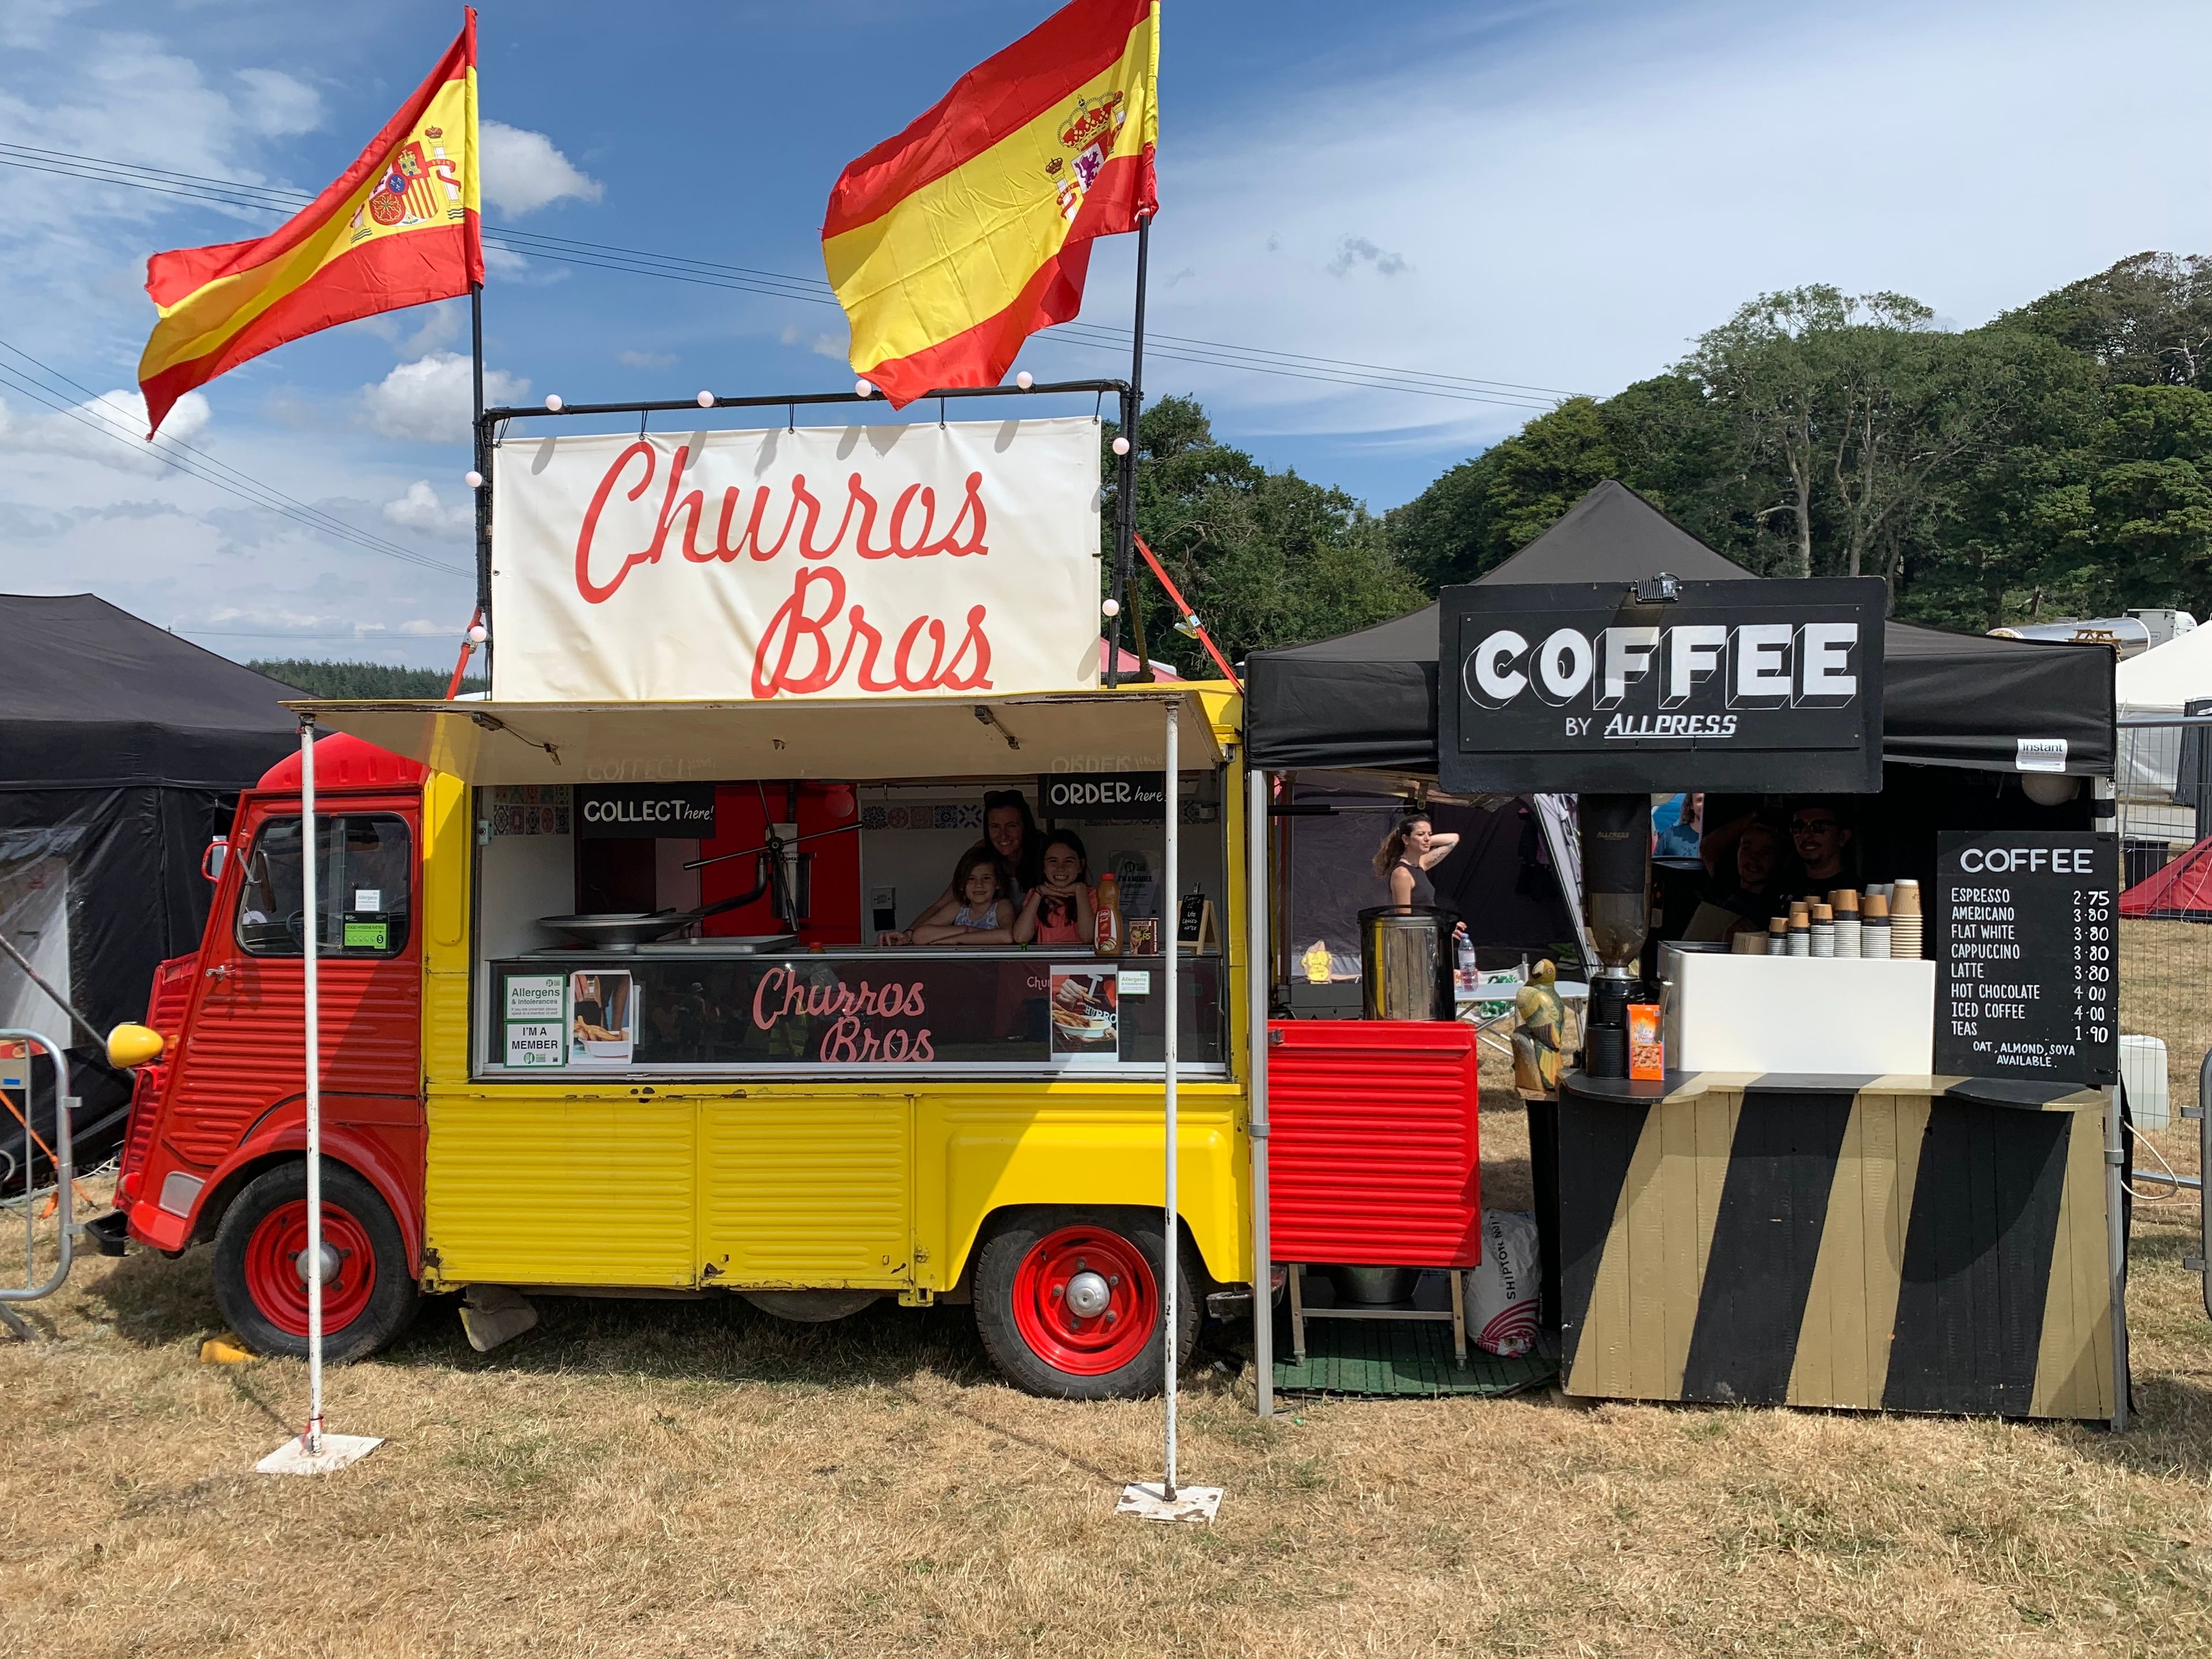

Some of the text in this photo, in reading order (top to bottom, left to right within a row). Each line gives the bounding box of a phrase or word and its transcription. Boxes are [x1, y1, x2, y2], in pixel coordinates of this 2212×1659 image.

[575, 441, 989, 604] Churros
[752, 566, 994, 699] Bros
[1464, 623, 1858, 710] COFFEE
[1566, 714, 1737, 737] BY ALLPRESS
[1051, 782, 1131, 805] ORDER
[584, 800, 714, 821] COLLECT here!
[1960, 849, 2094, 873] COFFEE
[1952, 888, 2010, 903] ESPRESSO
[1952, 906, 2014, 921] AMERICANO
[1952, 924, 1976, 939] FLAT
[1980, 925, 2015, 940] WHITE
[1952, 944, 2020, 959] CAPPUCCINO
[1951, 963, 1984, 978] LATTE
[512, 988, 560, 999] Allergens
[753, 967, 925, 1030] Churros
[1951, 983, 1974, 998] HOT
[1979, 984, 2040, 999] CHOCOLATE
[1952, 1002, 1979, 1018] ICED
[1985, 1003, 2025, 1019] COFFEE
[522, 1027, 547, 1036] I'M A
[1951, 1021, 1978, 1036] TEAS
[512, 1040, 558, 1049] MEMBER
[820, 1016, 934, 1062] Bros
[2049, 1044, 2075, 1056] SOYA
